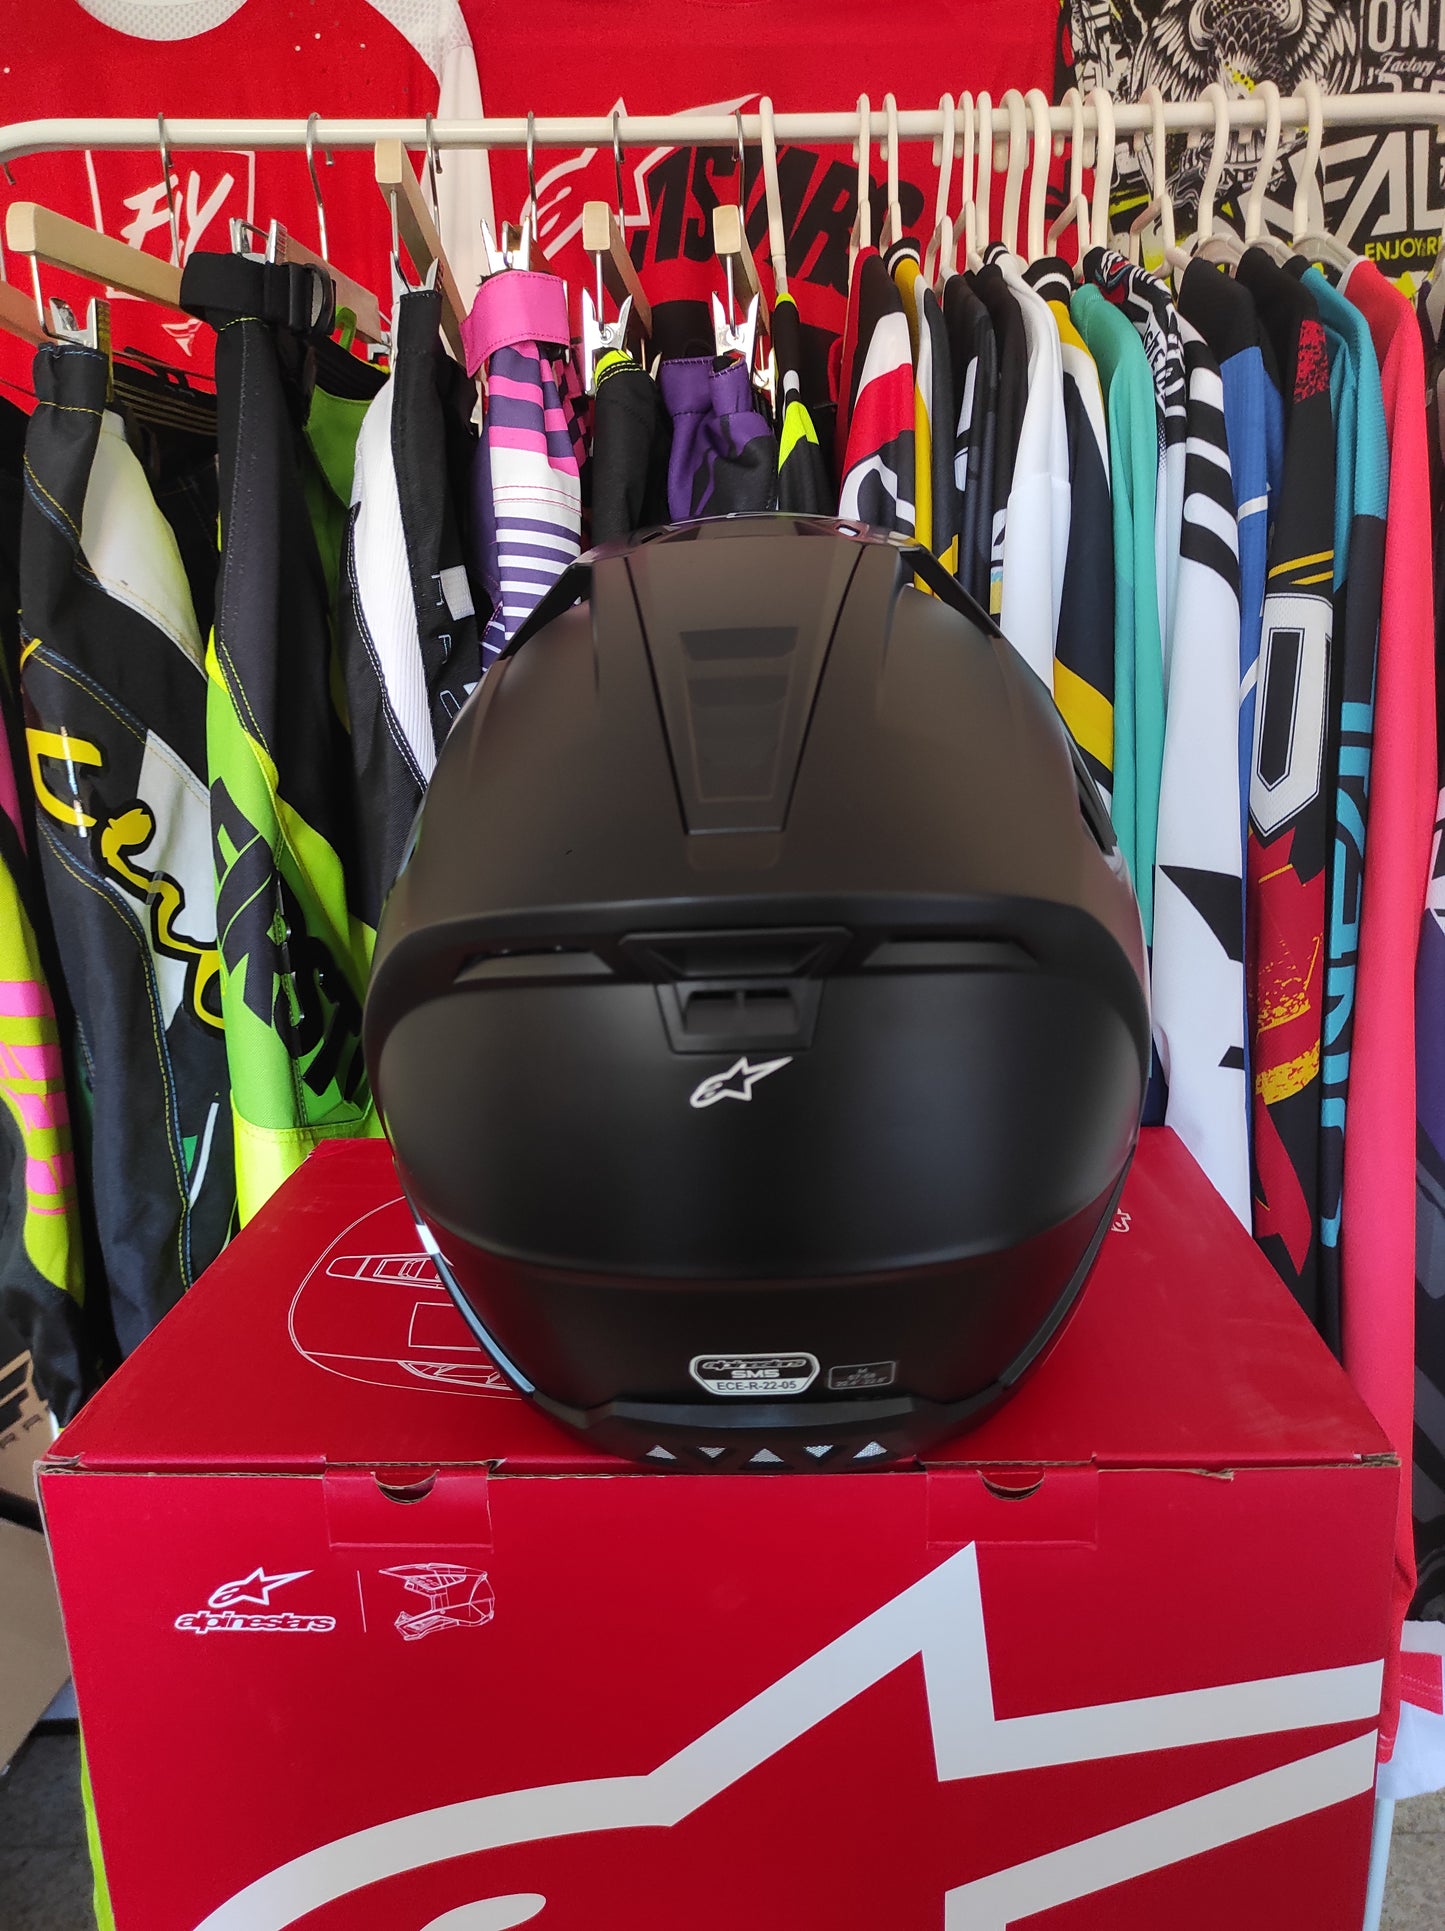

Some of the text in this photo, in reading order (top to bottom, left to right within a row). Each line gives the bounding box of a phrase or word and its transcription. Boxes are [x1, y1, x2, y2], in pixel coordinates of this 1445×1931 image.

[1364, 237, 1421, 264] ENJOY
[716, 1380, 797, 1391] ECE-R-22-05
[174, 1610, 337, 1635] alpinestars
